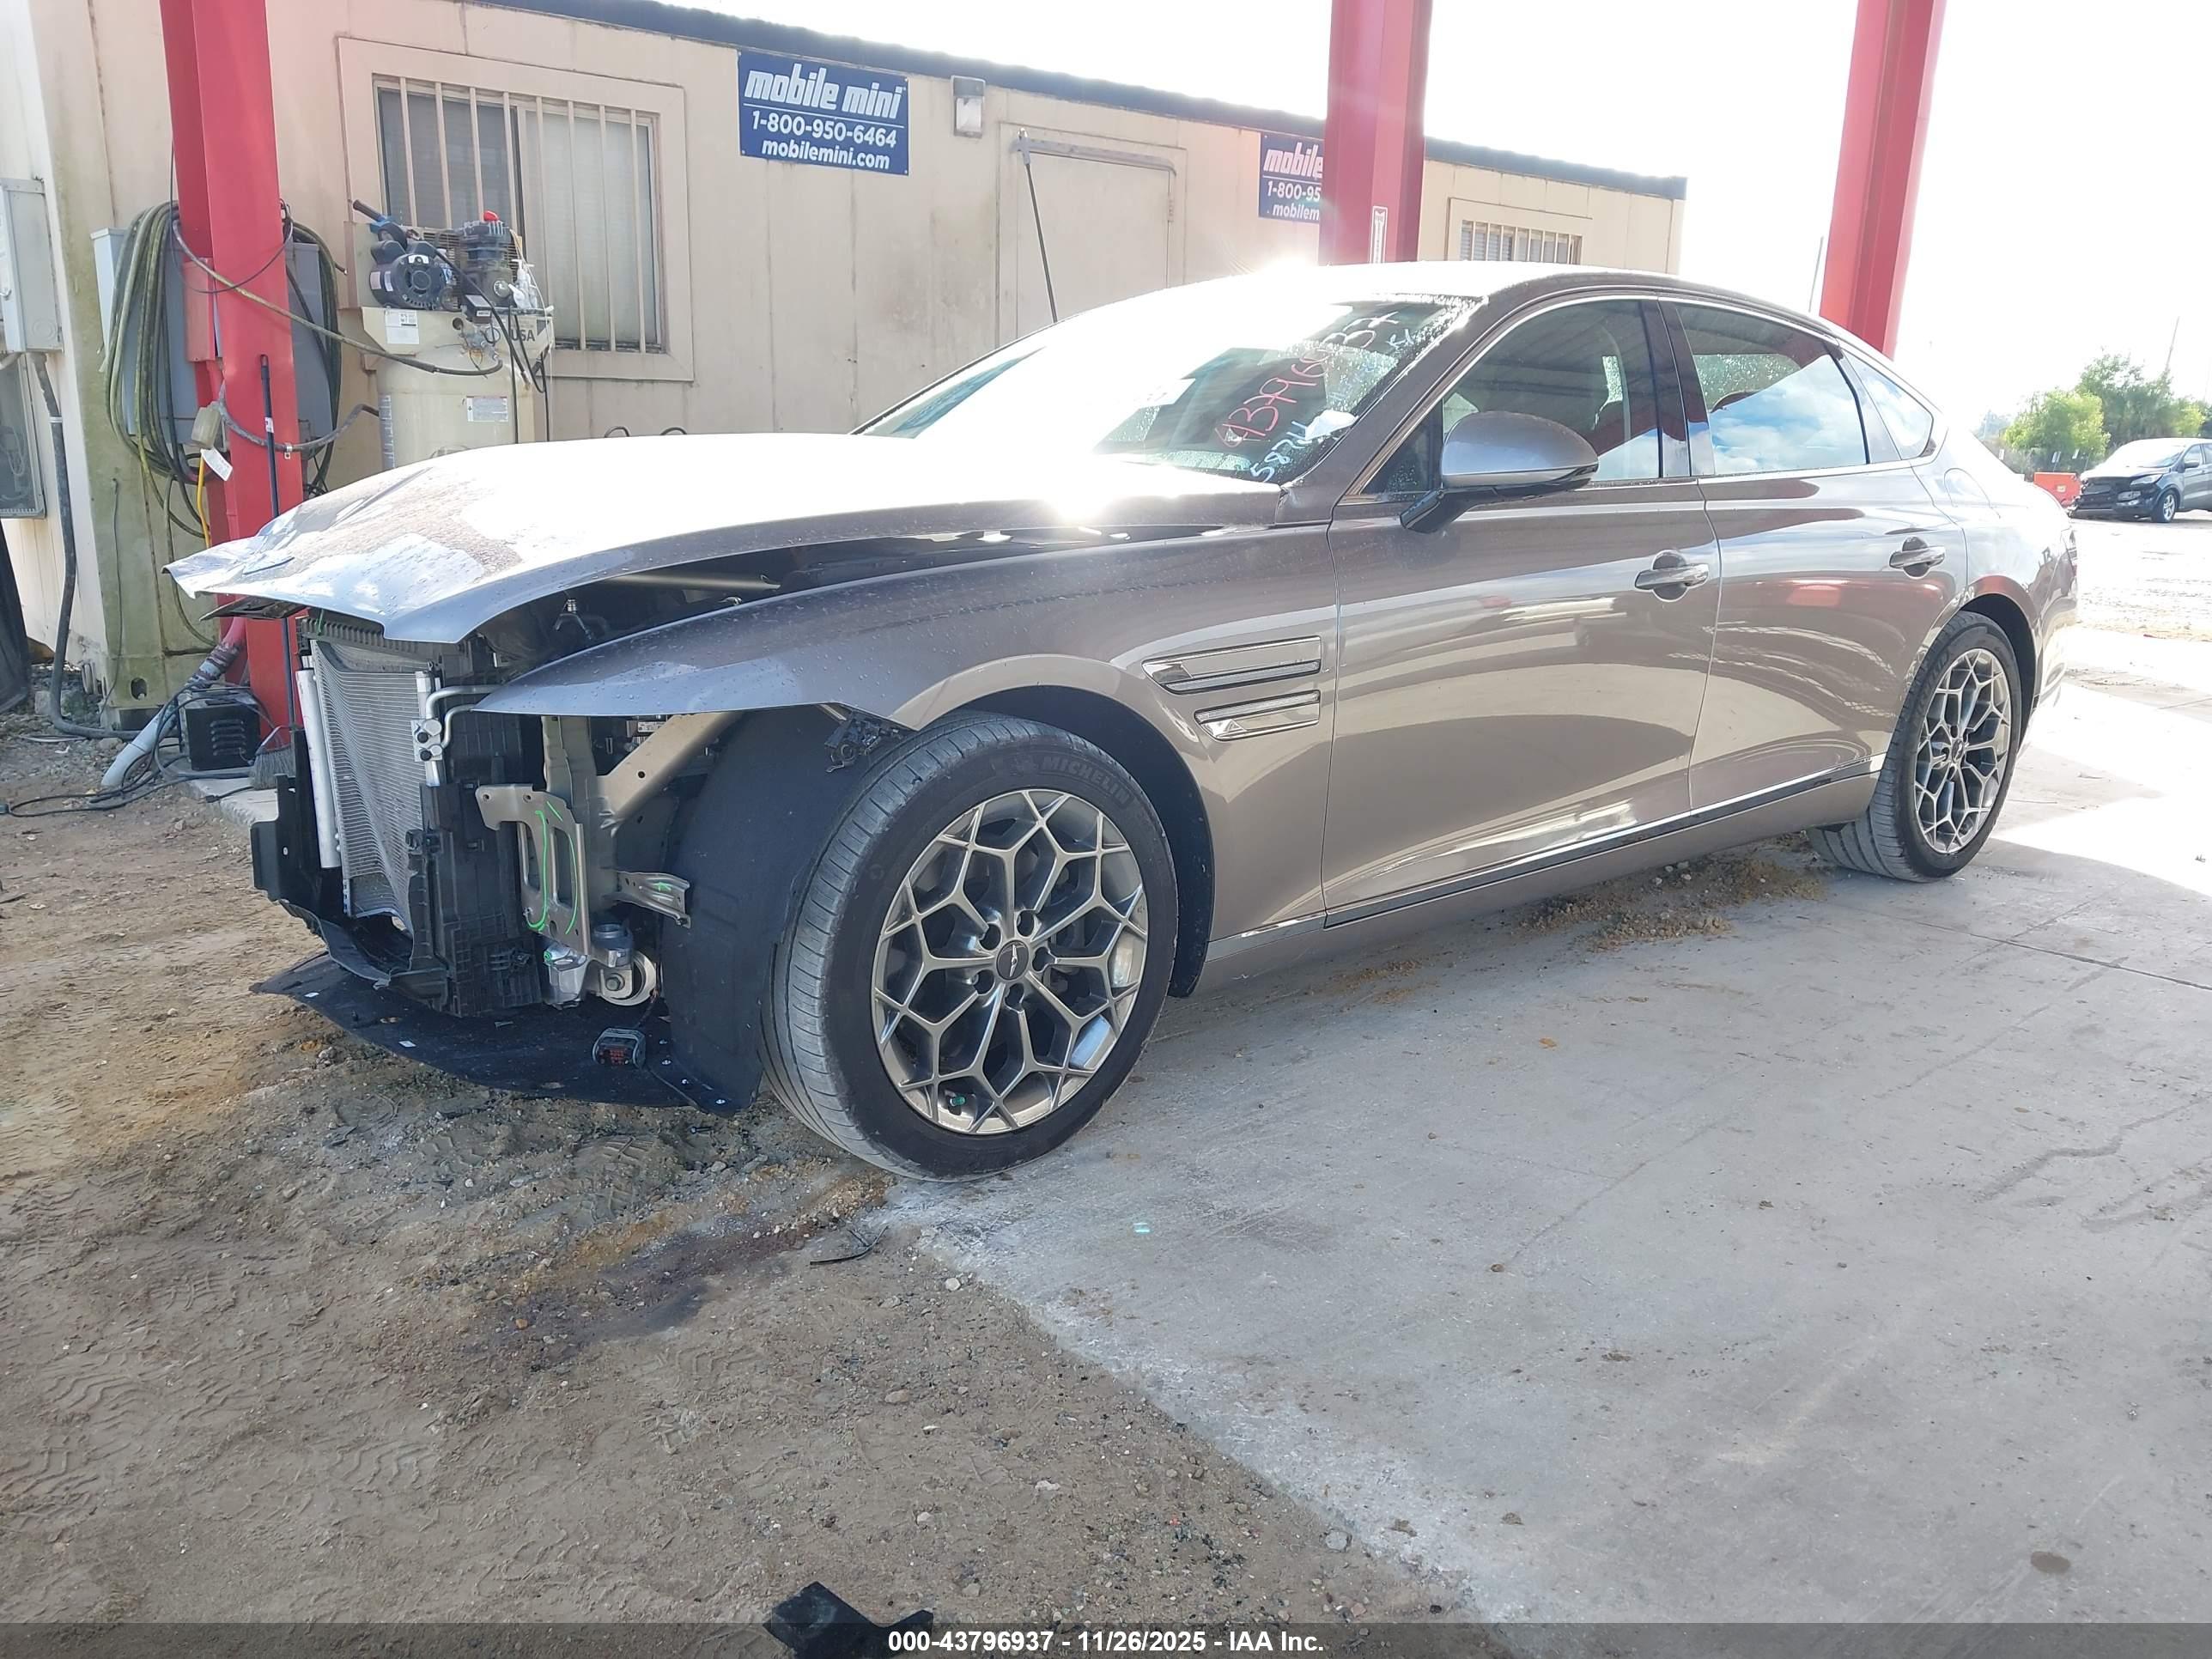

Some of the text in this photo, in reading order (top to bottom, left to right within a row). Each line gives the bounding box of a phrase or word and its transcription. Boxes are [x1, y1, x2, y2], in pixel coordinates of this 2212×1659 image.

[744, 63, 902, 118] mobile mini
[751, 110, 896, 148] 1-800-950-6464
[761, 139, 890, 169] mobilemini.com
[1263, 143, 1323, 179] mobile
[1042, 756, 1133, 805] MICHELIN
